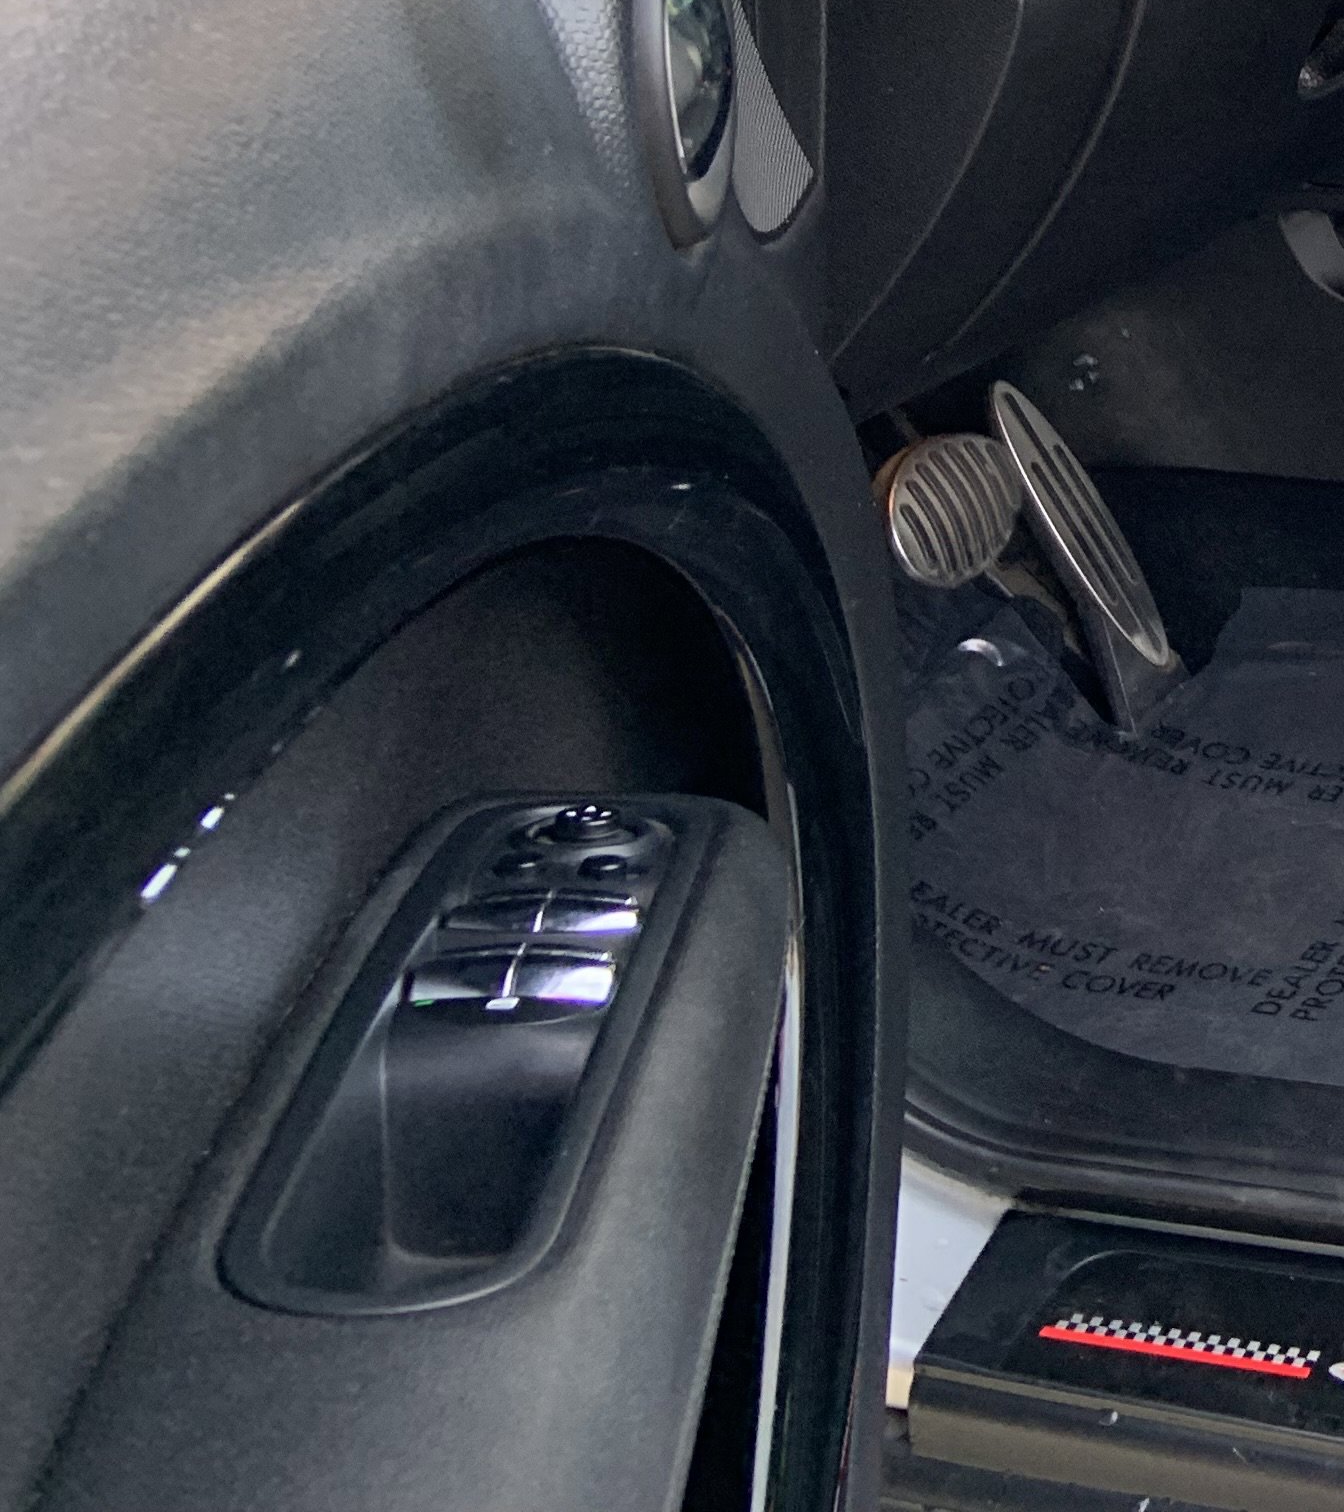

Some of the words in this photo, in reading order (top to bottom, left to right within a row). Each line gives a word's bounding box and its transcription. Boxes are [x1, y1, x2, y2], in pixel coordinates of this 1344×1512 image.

[1201, 768, 1297, 796] MUST
[1016, 929, 1119, 965] MUST
[1129, 951, 1274, 988] REMOVE
[1250, 940, 1341, 1016] DEALER
[1061, 969, 1177, 1002] COVER
